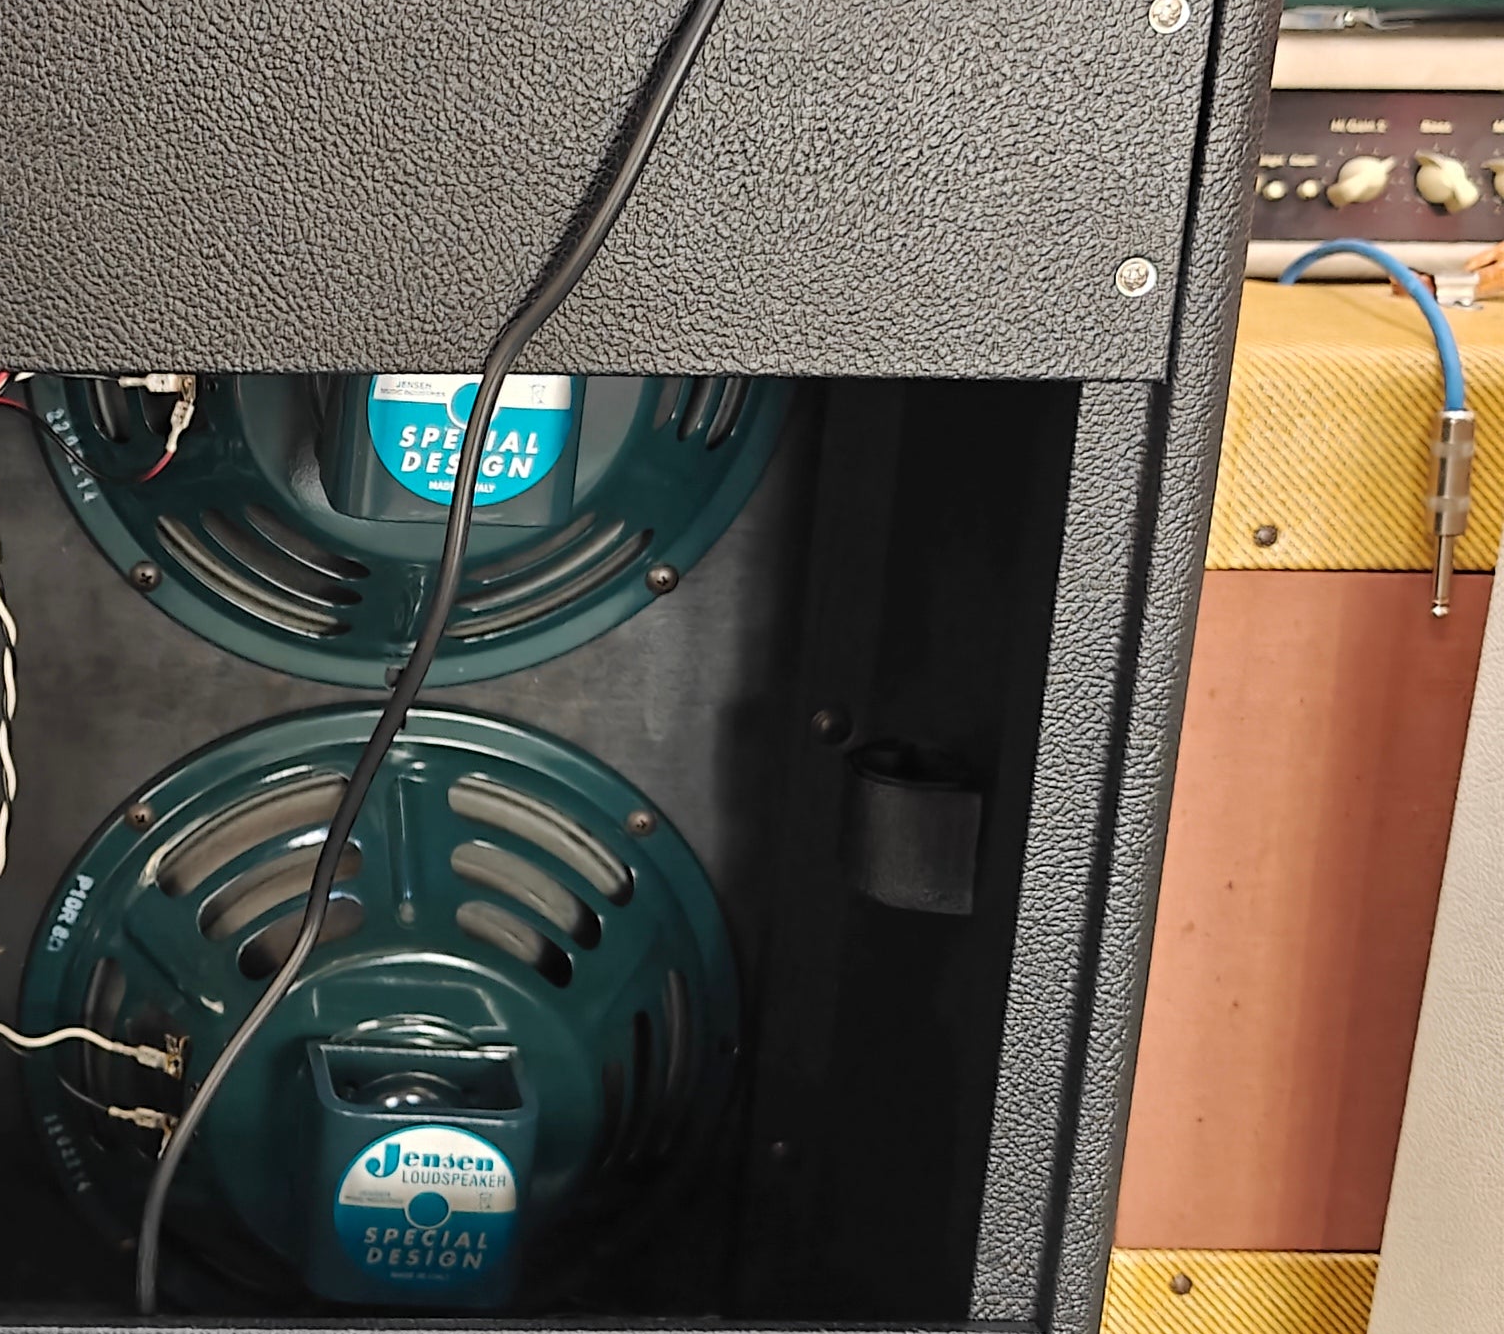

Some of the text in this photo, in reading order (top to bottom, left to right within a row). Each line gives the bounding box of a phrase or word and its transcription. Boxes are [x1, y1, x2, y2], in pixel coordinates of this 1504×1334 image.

[399, 425, 540, 455] SPEIAL
[401, 450, 533, 479] DESGN
[365, 1143, 494, 1178] Jensen
[402, 1170, 506, 1188] LOUDSPEAKER
[364, 1227, 488, 1249] SPECIAL
[366, 1247, 483, 1268] DESIGN
